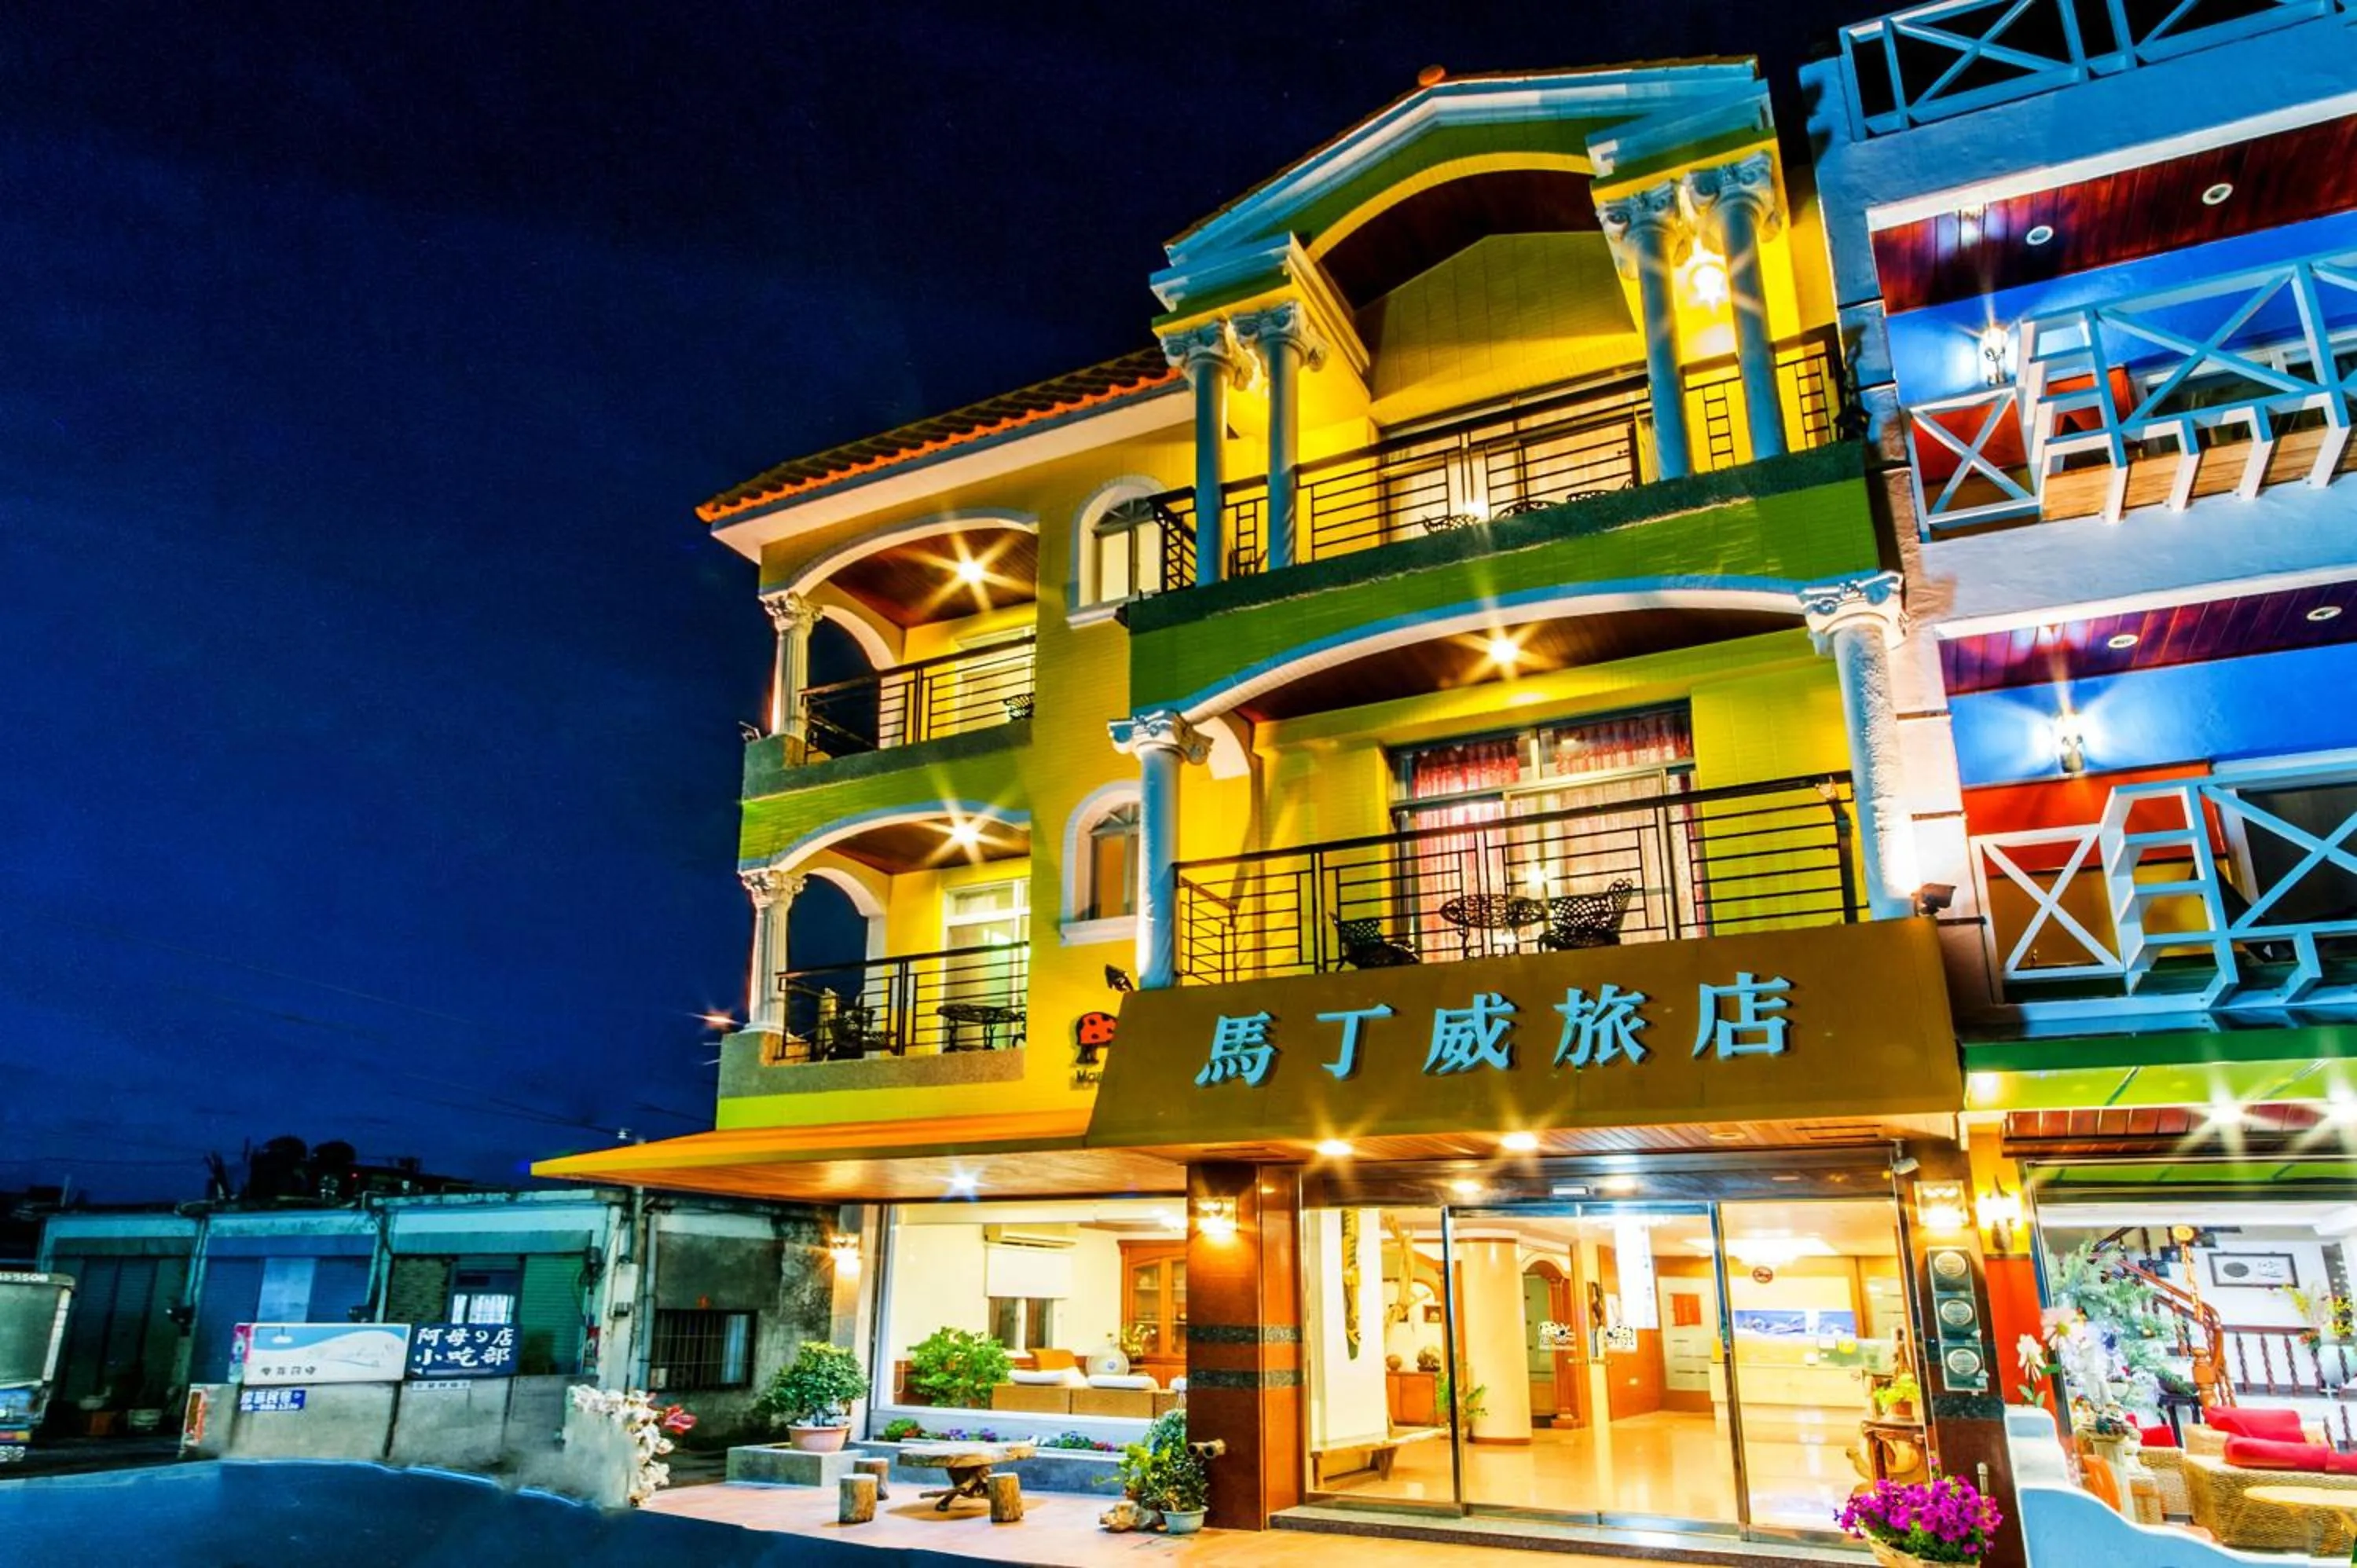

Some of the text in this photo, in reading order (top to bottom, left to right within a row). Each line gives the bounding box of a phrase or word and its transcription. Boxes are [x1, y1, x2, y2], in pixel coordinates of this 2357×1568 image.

[1196, 971, 1793, 1086] 馬丁威旅店
[415, 1346, 510, 1367] 小吃部
